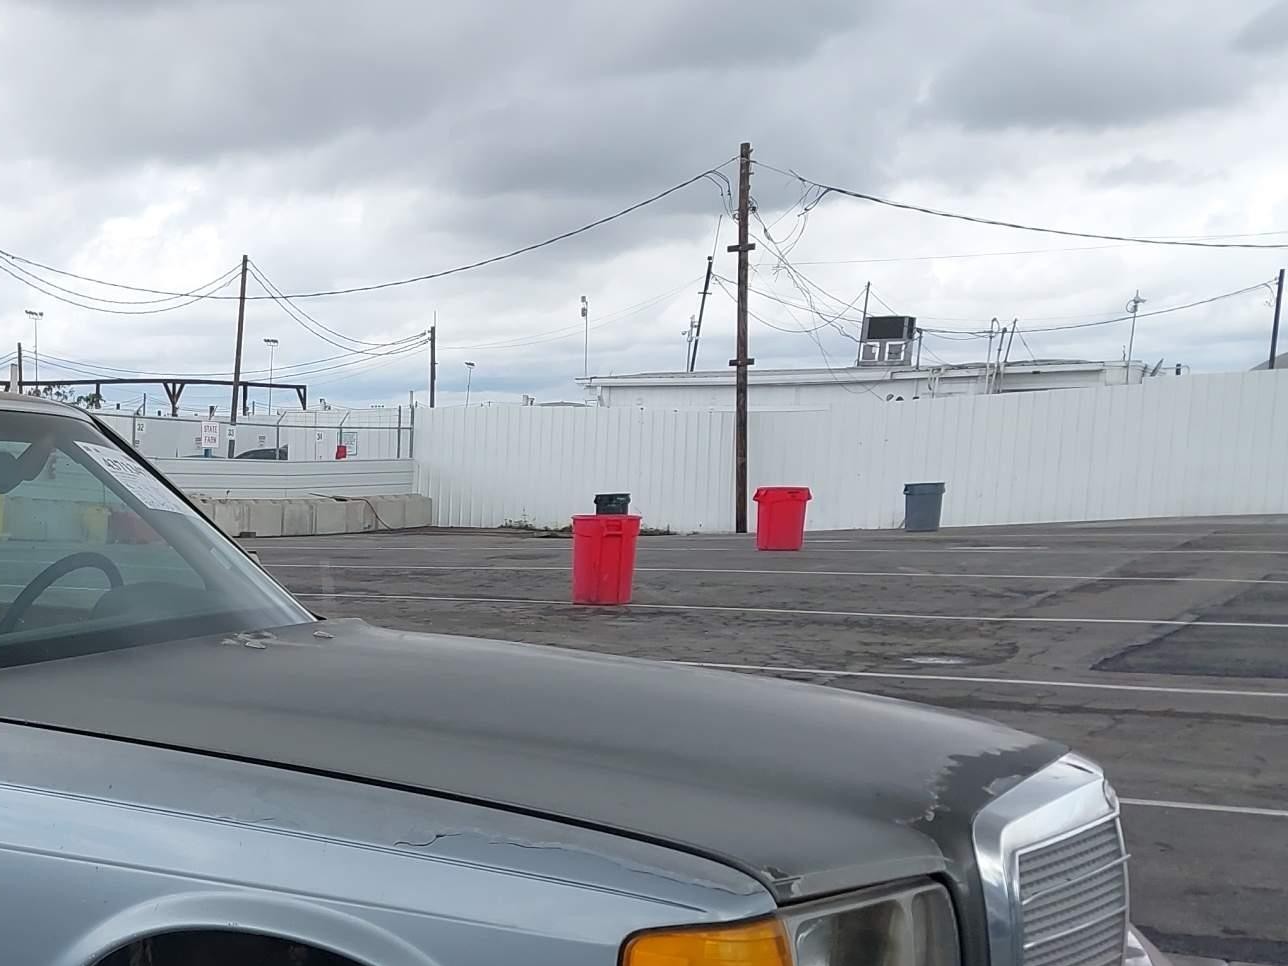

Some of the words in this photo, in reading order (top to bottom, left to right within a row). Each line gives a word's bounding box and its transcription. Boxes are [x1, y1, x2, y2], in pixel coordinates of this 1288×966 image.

[137, 423, 144, 431] 32
[204, 425, 217, 433] STATE
[204, 436, 217, 444] FARM
